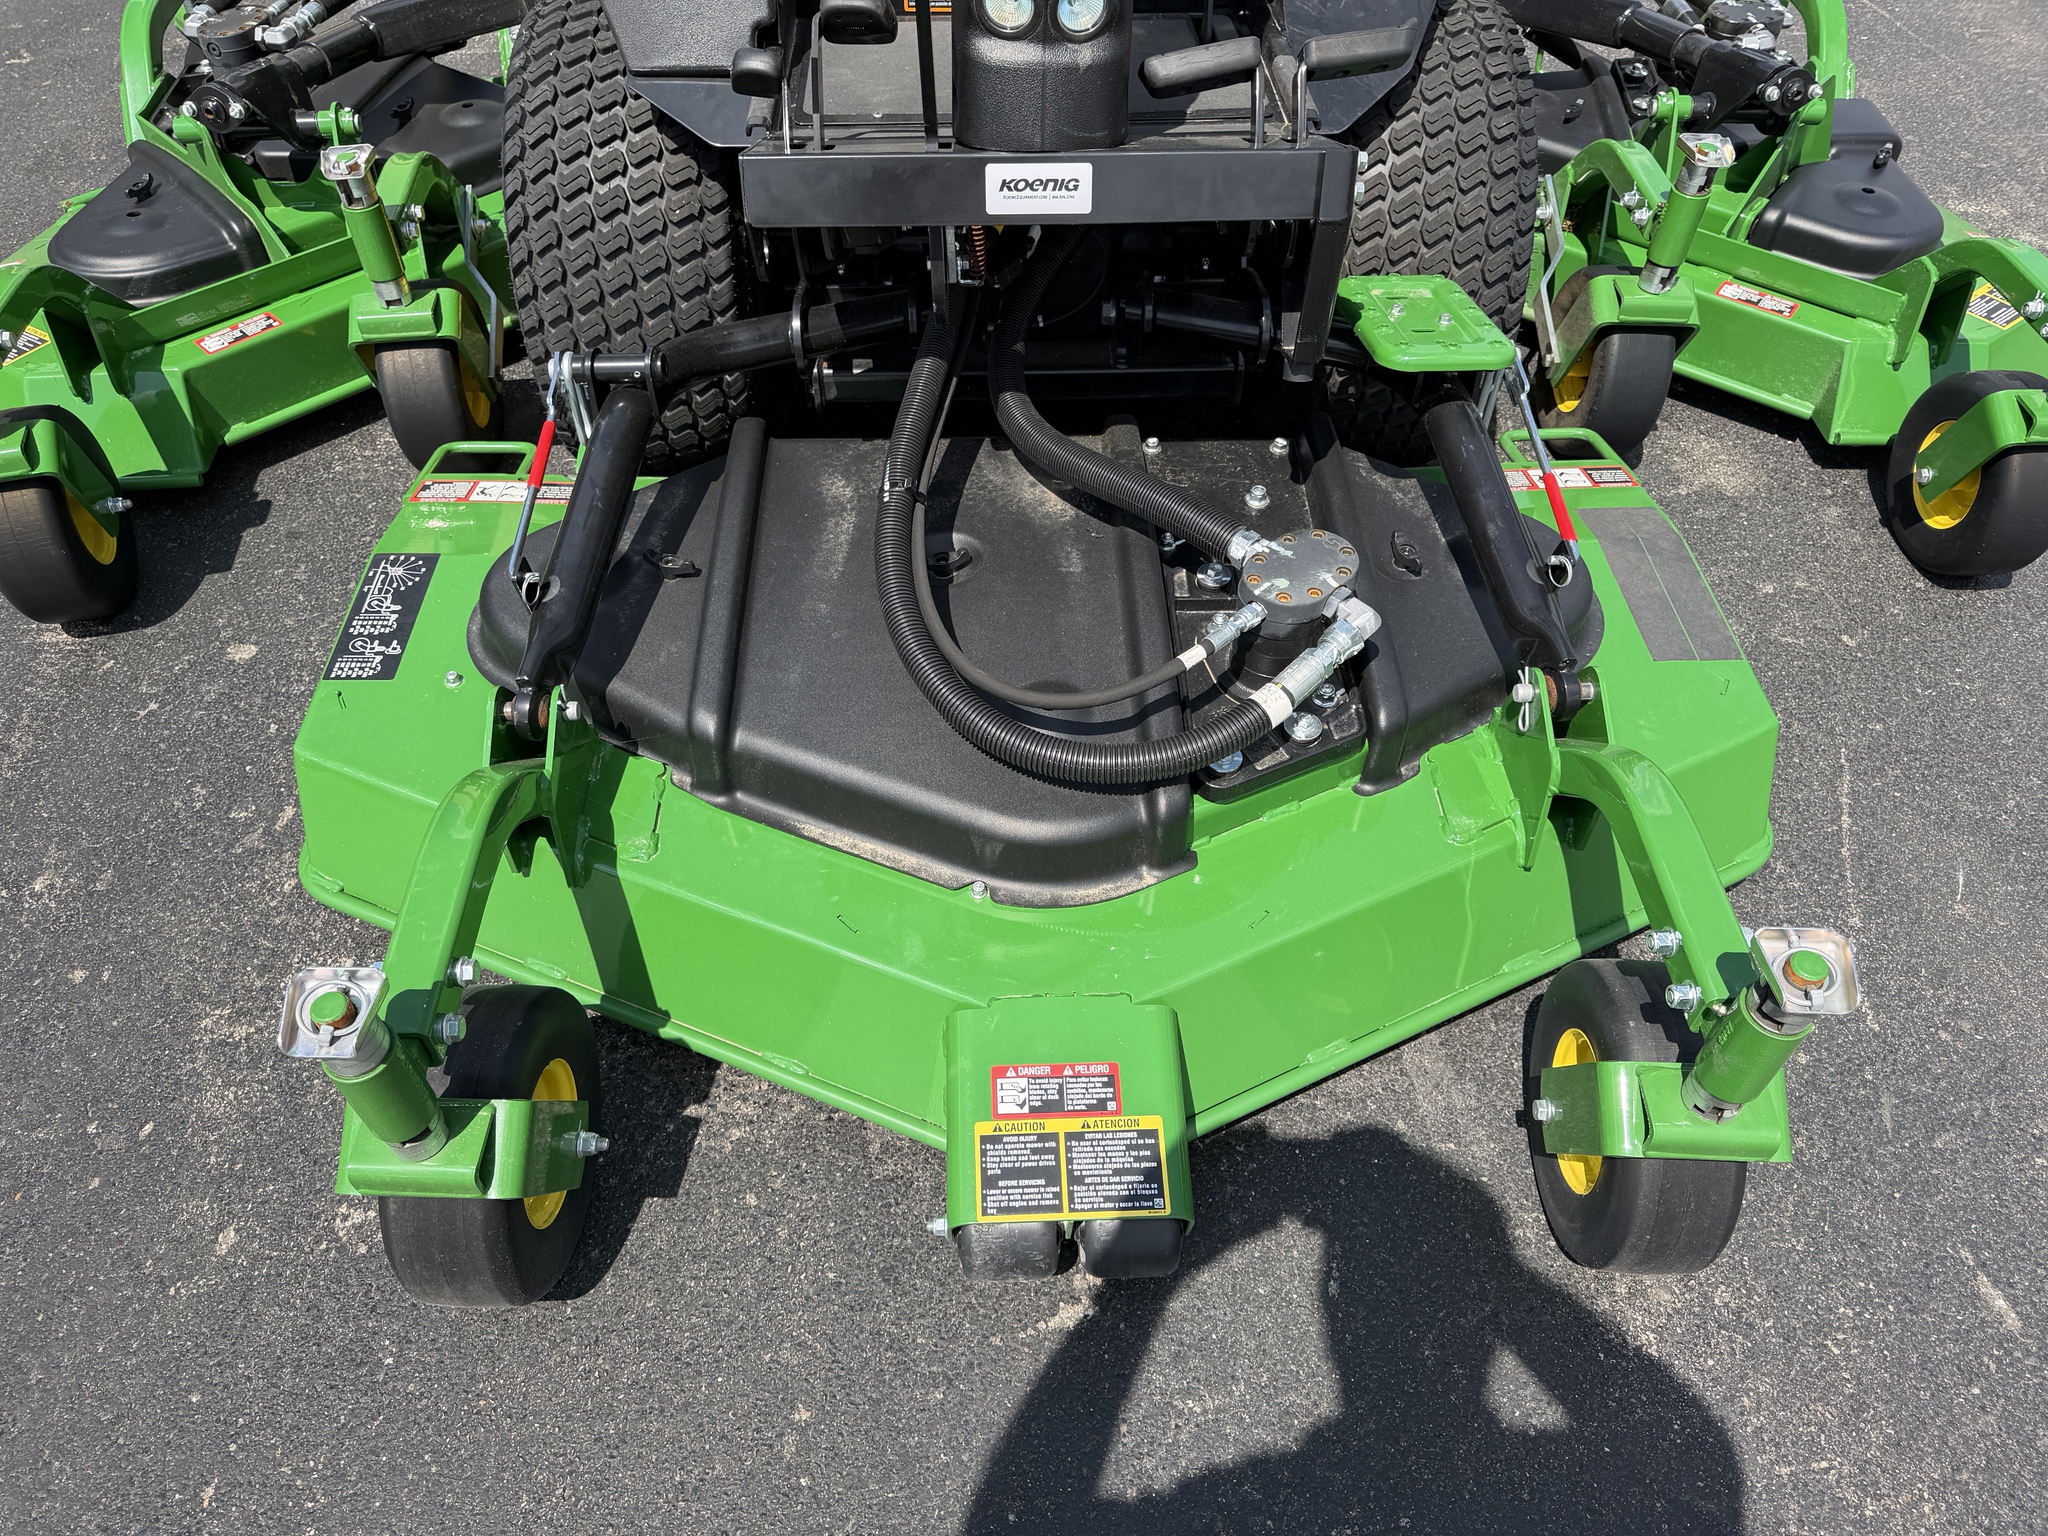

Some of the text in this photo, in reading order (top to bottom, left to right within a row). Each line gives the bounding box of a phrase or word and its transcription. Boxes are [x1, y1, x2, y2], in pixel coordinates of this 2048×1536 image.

[1018, 1065, 1109, 1075] DANGER PELIGRO
[1005, 1122, 1045, 1132] CAUTION
[1093, 1119, 1140, 1129] ATENCION
